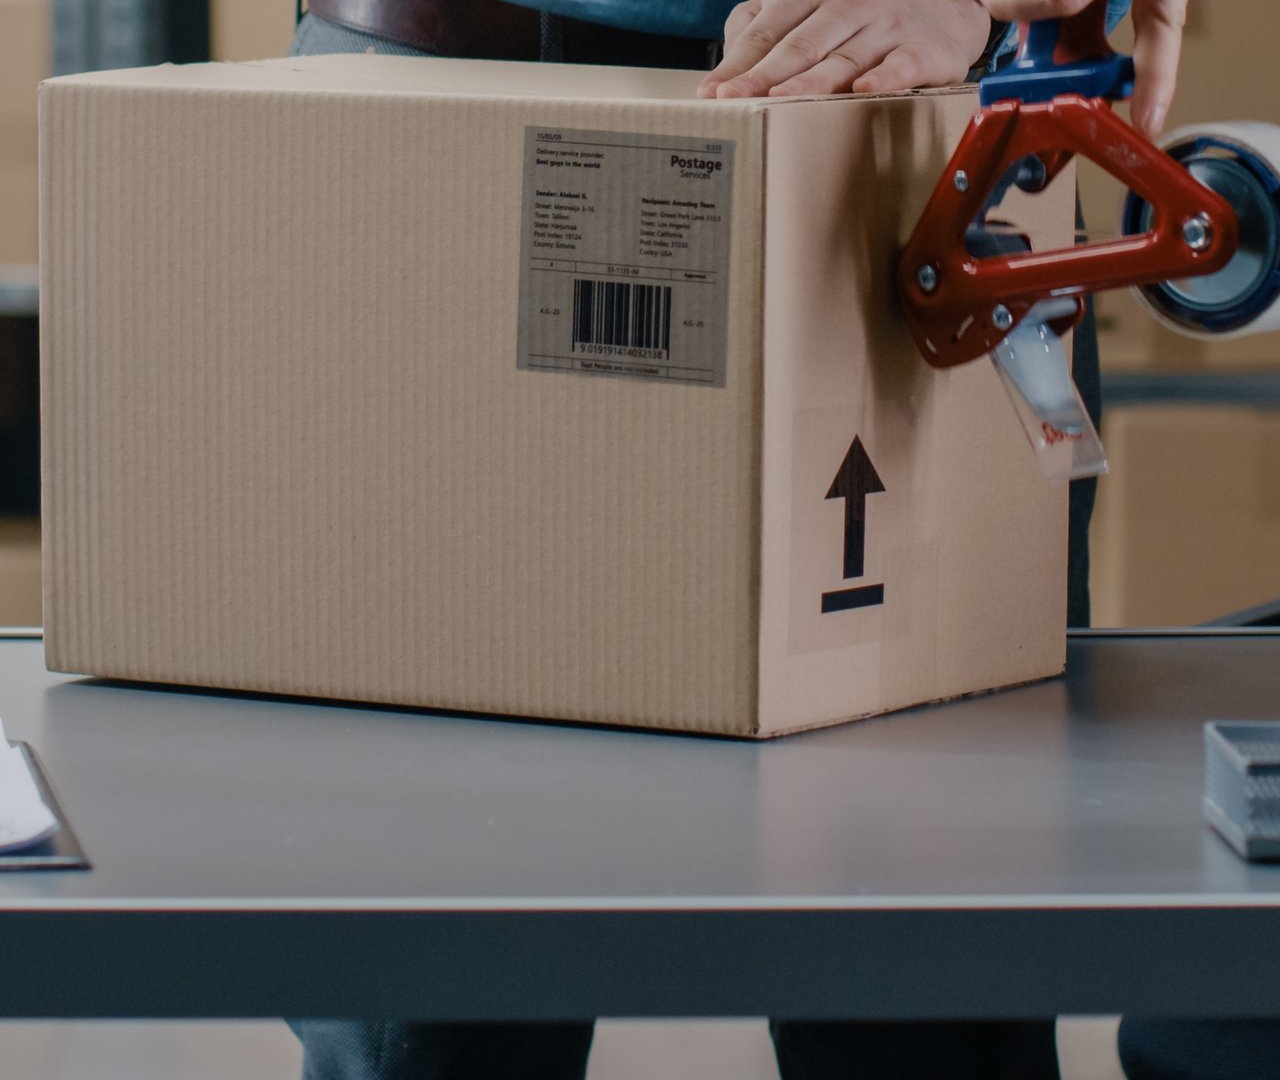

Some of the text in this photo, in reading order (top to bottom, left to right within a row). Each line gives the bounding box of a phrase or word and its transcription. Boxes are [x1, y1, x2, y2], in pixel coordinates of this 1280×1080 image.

[537, 148, 558, 157] Delivery
[671, 155, 722, 173] Postage
[680, 169, 711, 180] Services
[672, 200, 698, 209] Amazing
[580, 344, 586, 353] 9
